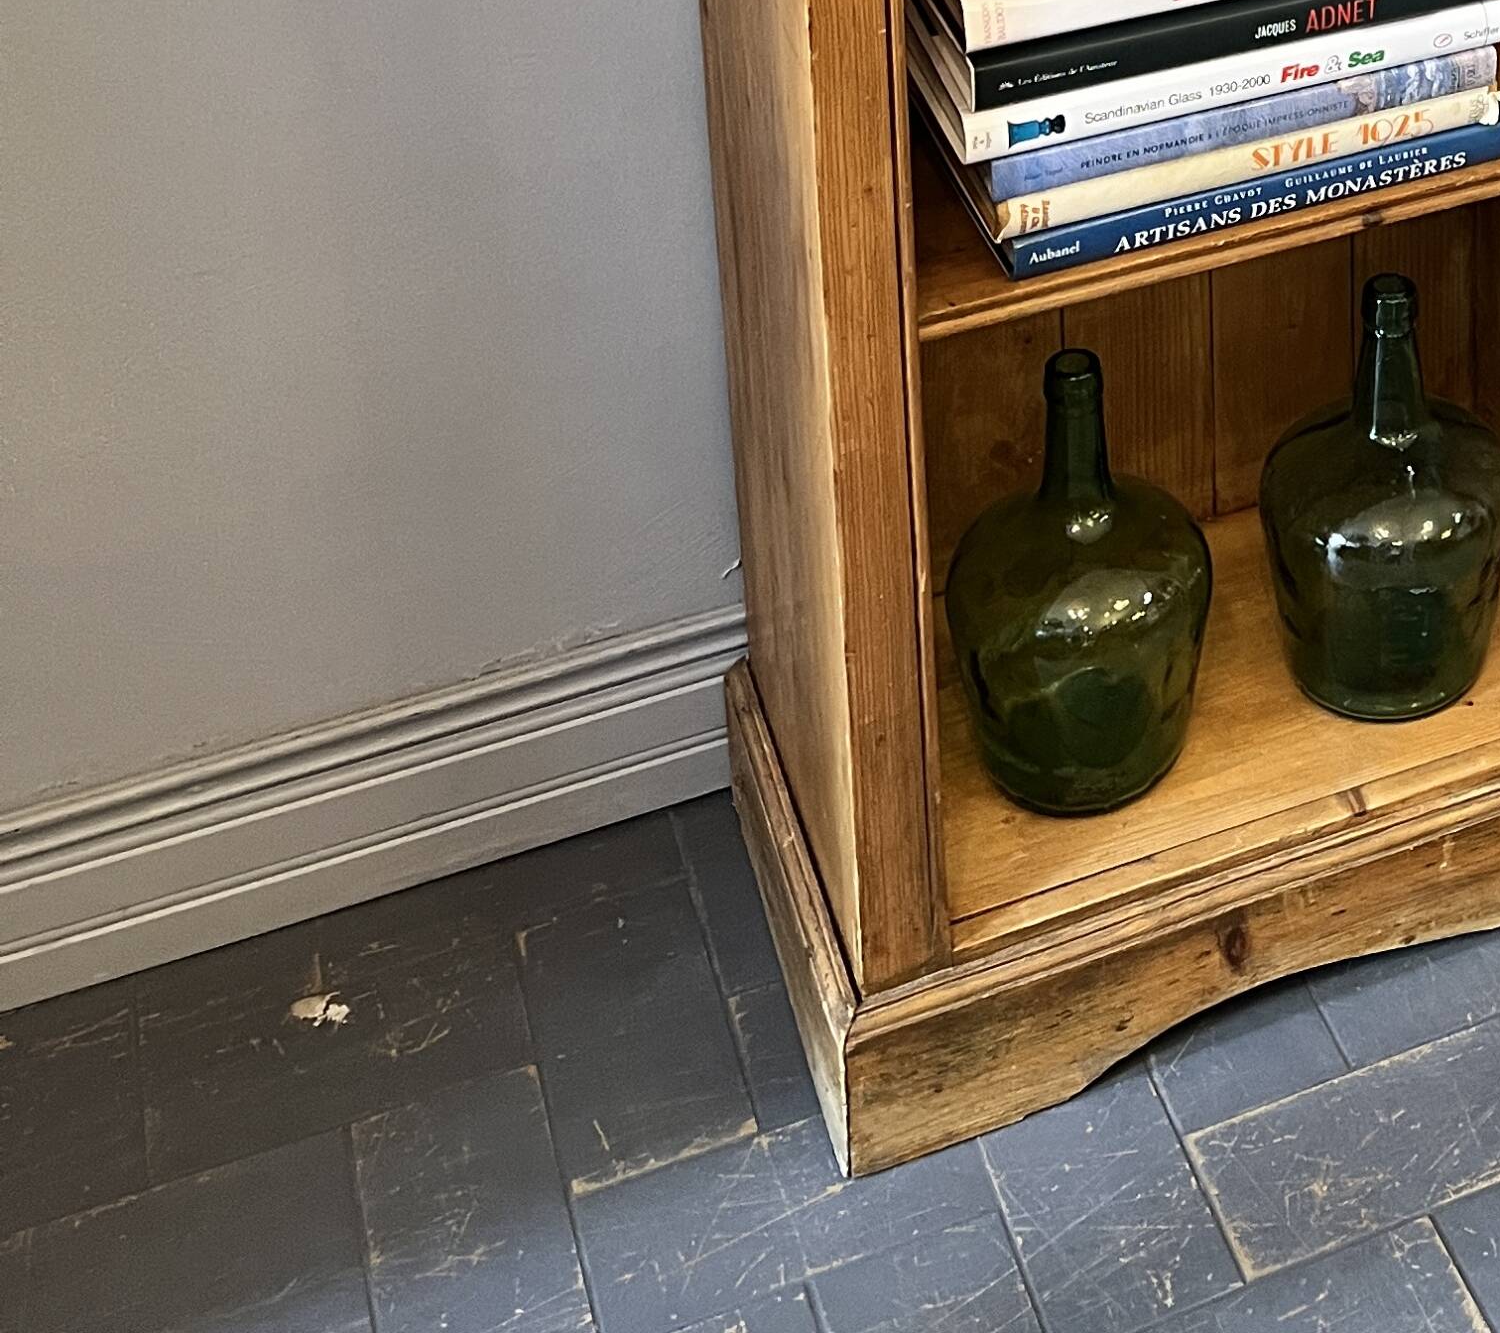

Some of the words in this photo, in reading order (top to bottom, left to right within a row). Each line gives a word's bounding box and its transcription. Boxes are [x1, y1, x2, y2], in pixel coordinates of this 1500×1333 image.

[1254, 17, 1297, 40] JACQUES
[1084, 98, 1166, 125] Scandinavian
[1168, 91, 1202, 108] Glass
[1209, 73, 1271, 98] 1930-2000
[1280, 62, 1320, 84] Fire
[1324, 54, 1342, 75] &
[1347, 48, 1385, 69] Sea
[1080, 152, 1124, 170] PEINDRE
[1126, 148, 1141, 160] EN
[1143, 133, 1204, 156] NORMANDIE
[1250, 129, 1340, 172] STYLE
[1113, 206, 1242, 254] ARTISANS
[1250, 196, 1297, 219] DES
[1305, 151, 1467, 206] MONASTÈRES
[1028, 241, 1081, 266] Aubanel
